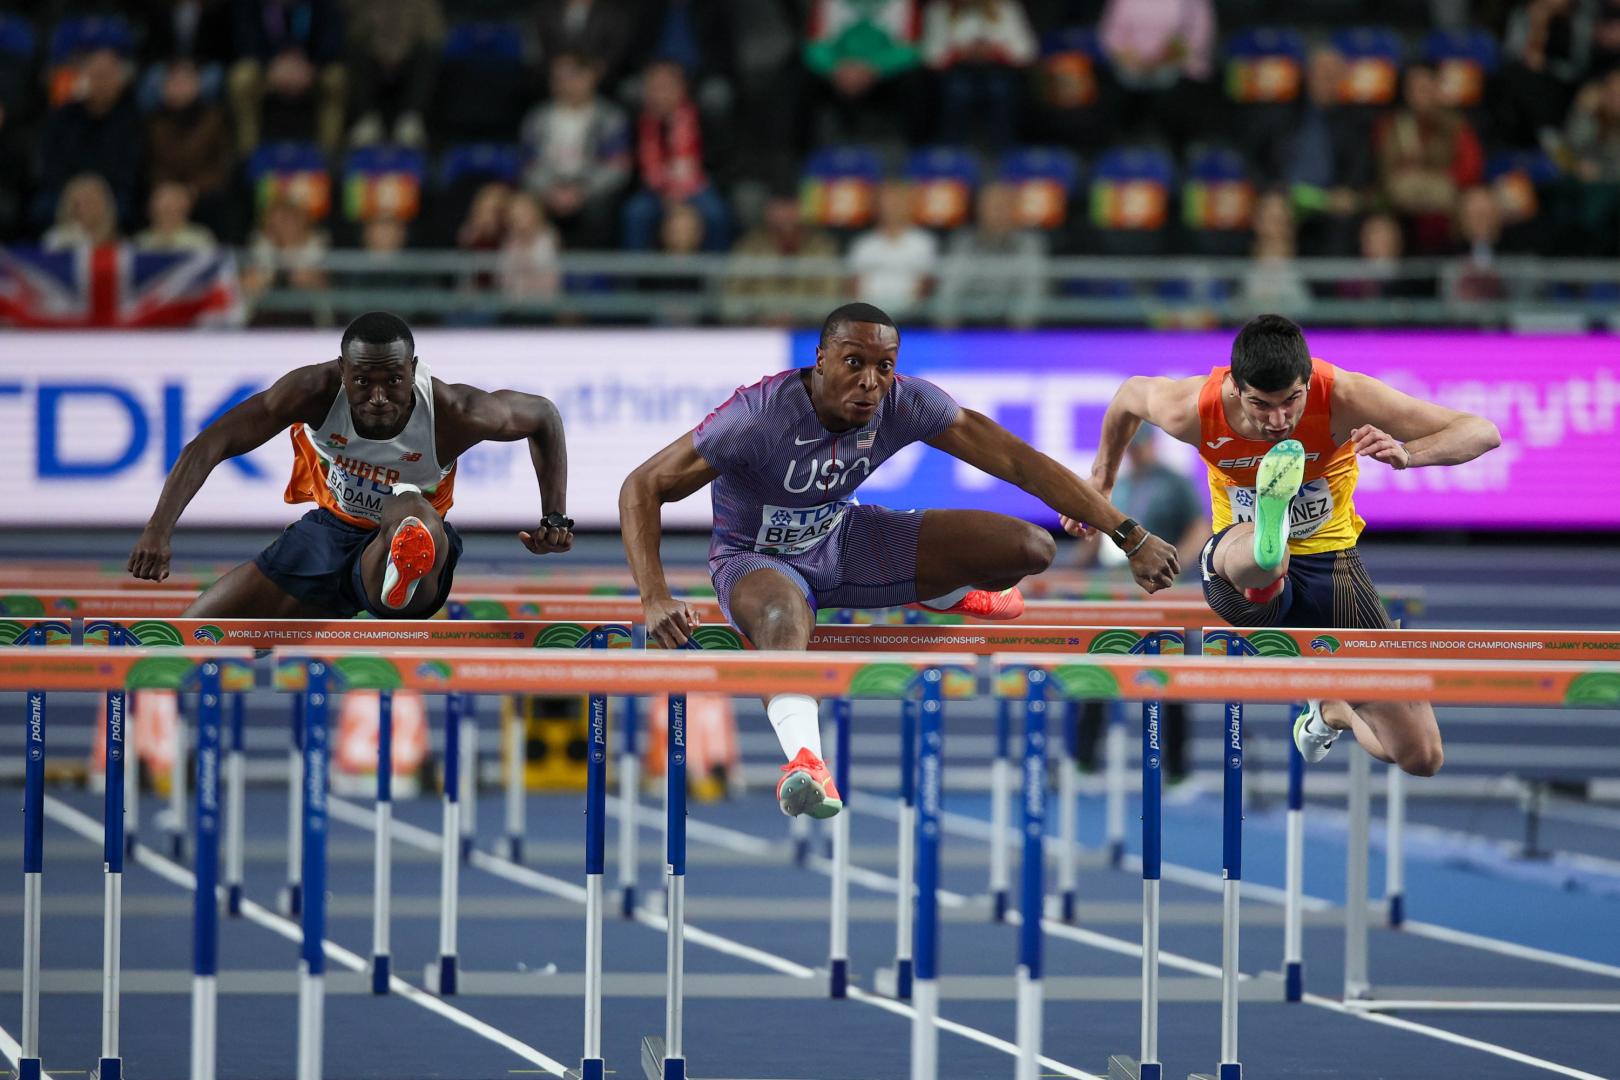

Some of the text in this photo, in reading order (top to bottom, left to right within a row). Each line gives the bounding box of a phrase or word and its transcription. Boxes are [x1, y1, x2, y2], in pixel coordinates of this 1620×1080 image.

[0, 383, 268, 478] DK
[330, 470, 383, 513] BADAM
[334, 454, 401, 487] NIGER
[783, 456, 871, 494] USA
[228, 630, 261, 639] WORLD
[263, 630, 312, 639] ATHLETICS
[315, 631, 351, 639] INDOOR
[352, 631, 430, 640] CHAMPIONSHIPS
[822, 635, 871, 644] ATHLETICS
[873, 636, 909, 644] INDOOR
[911, 636, 986, 645] CHAMPIONSHIPS
[1344, 640, 1377, 649] WORLD
[1379, 640, 1428, 649] ATHLETICS
[1430, 640, 1466, 649] INDOOR
[1468, 641, 1543, 650] CHAMPIONSHIPS
[30, 695, 42, 742] polanik
[110, 695, 123, 742] polanik
[592, 698, 605, 745] polanik
[672, 700, 685, 746] polanik
